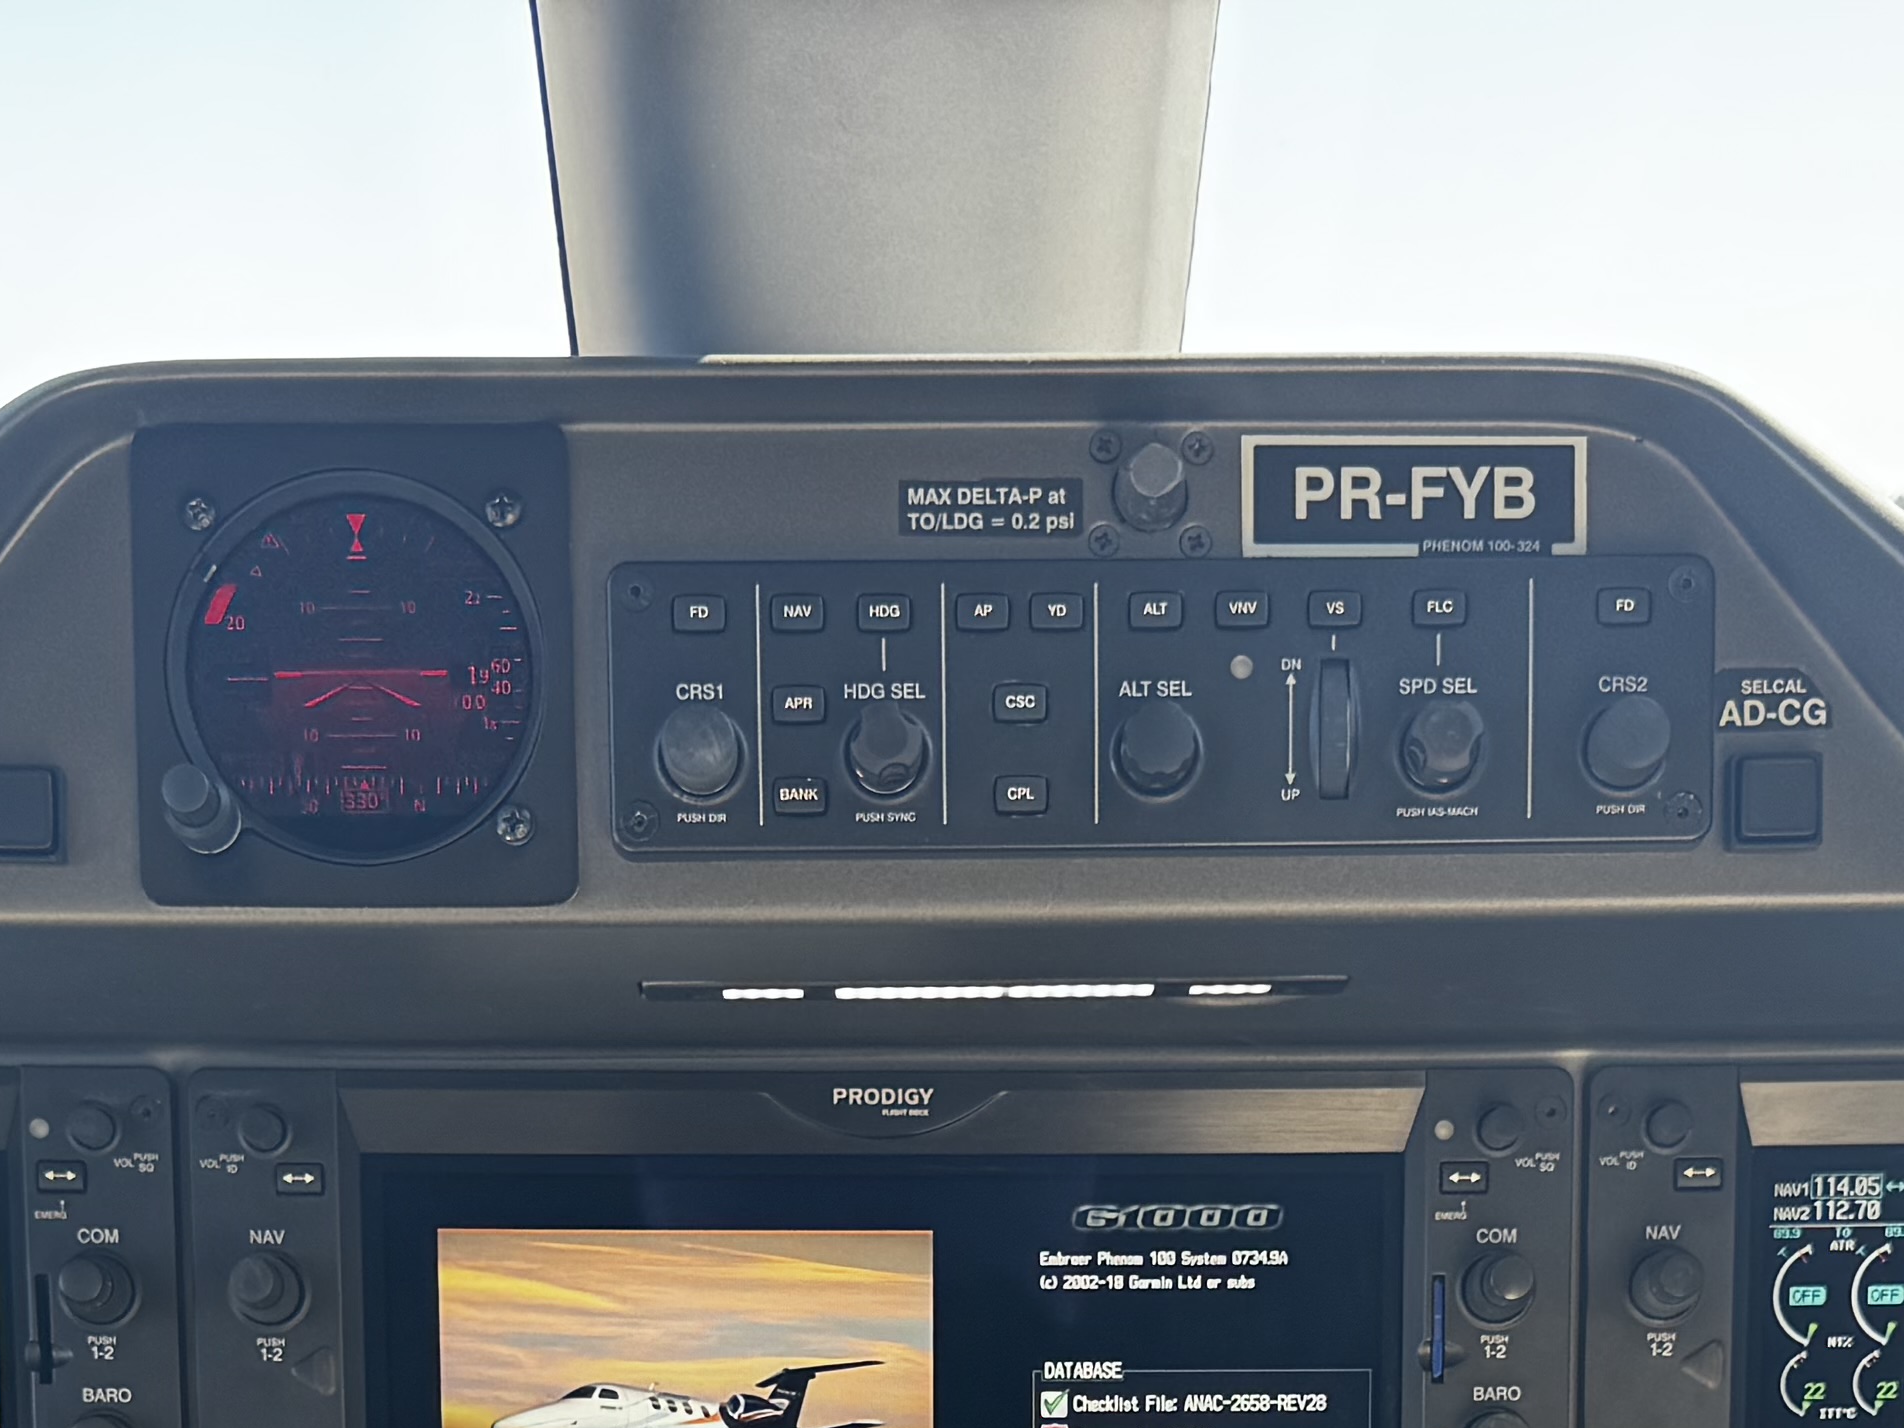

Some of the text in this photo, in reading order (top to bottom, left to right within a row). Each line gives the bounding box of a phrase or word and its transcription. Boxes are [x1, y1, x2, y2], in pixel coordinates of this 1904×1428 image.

[907, 487, 1066, 506] MAX DELTA-P at
[1295, 465, 1536, 520] PR-FYB
[906, 511, 1075, 534] TO/LDG = 0.2 psi
[1422, 539, 1484, 552] PHENOM
[689, 605, 709, 619] FD
[783, 604, 812, 618] NAV
[869, 604, 901, 618] HDG
[974, 604, 993, 617] AP
[1047, 603, 1067, 617] YD
[1143, 601, 1168, 616] ALT
[1228, 601, 1258, 614] VNV
[1326, 600, 1345, 615] VS
[1427, 600, 1454, 613] FLC
[1616, 598, 1635, 612] FD
[843, 682, 926, 700] HDG SEL
[1118, 680, 1193, 697] ALT SEL
[1399, 677, 1478, 695] SPD SEL
[1598, 675, 1648, 693] CRS2
[1741, 678, 1807, 695] SELCAL
[675, 683, 723, 701] CRS1
[784, 696, 813, 710] APR
[1005, 694, 1036, 709] CSC
[1718, 697, 1827, 727] AD-CG
[779, 787, 819, 801] BANK
[1007, 786, 1035, 801] CPL
[832, 1087, 934, 1105] PRODIGY
[76, 1227, 119, 1244] COM
[1044, 1361, 1124, 1380] DATABASE
[82, 1387, 132, 1403] BARO
[1072, 1394, 1140, 1413] Checklist
[1145, 1394, 1178, 1413] File:
